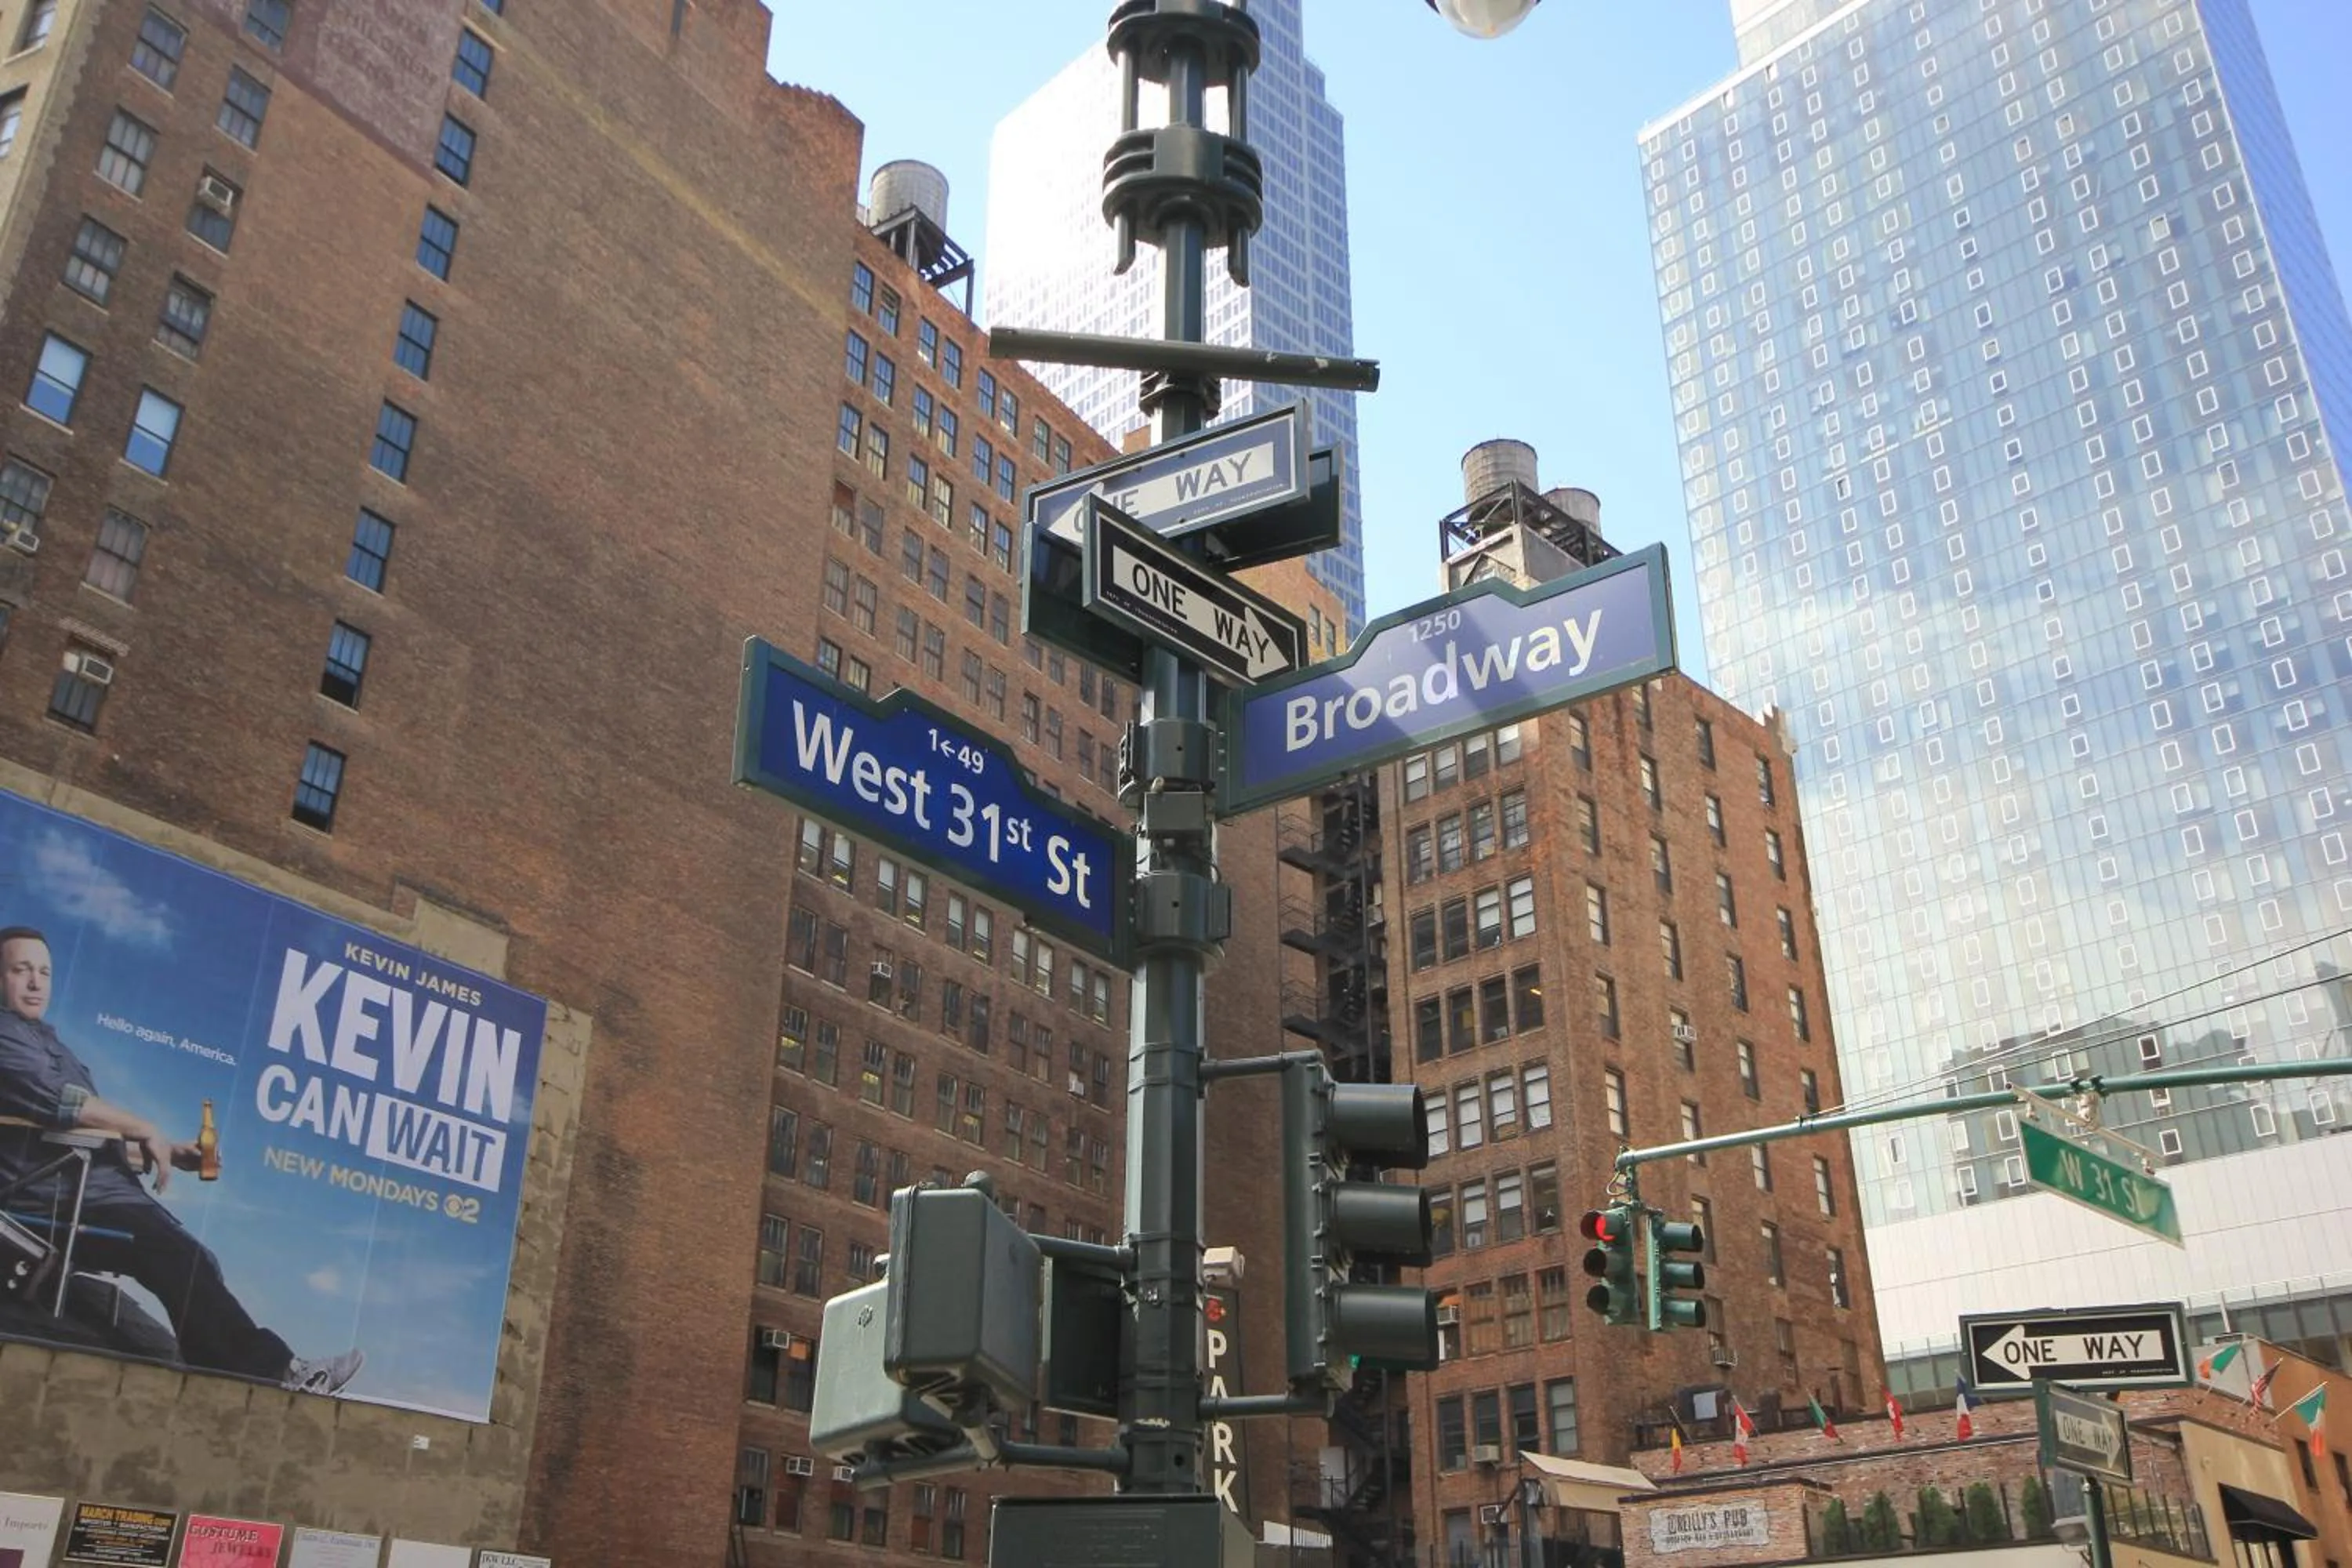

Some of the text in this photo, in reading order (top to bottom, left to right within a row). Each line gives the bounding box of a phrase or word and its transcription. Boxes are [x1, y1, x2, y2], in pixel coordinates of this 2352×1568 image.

[1175, 452, 1253, 502] WAY
[1132, 563, 1188, 620] ONE
[1214, 606, 1269, 664] WAY
[1409, 609, 1461, 642] 1250
[1286, 608, 1602, 753] Broadway
[793, 699, 1092, 909] West 31st St
[344, 942, 483, 1007] KEVIN JAMES
[96, 1012, 237, 1067] Hello again, America.
[268, 947, 522, 1124] KEVIN
[256, 1064, 497, 1182] CAN WAIT
[263, 1145, 325, 1181] NEW
[329, 1163, 438, 1212] MONDAYS
[2059, 1148, 2084, 1192] W
[2089, 1162, 2117, 1205] 31
[2004, 1334, 2144, 1364] ONE WAY
[1207, 1329, 1240, 1513] PARK
[2063, 1415, 2114, 1456] ONE WAY
[1724, 1508, 1748, 1528] PUB
